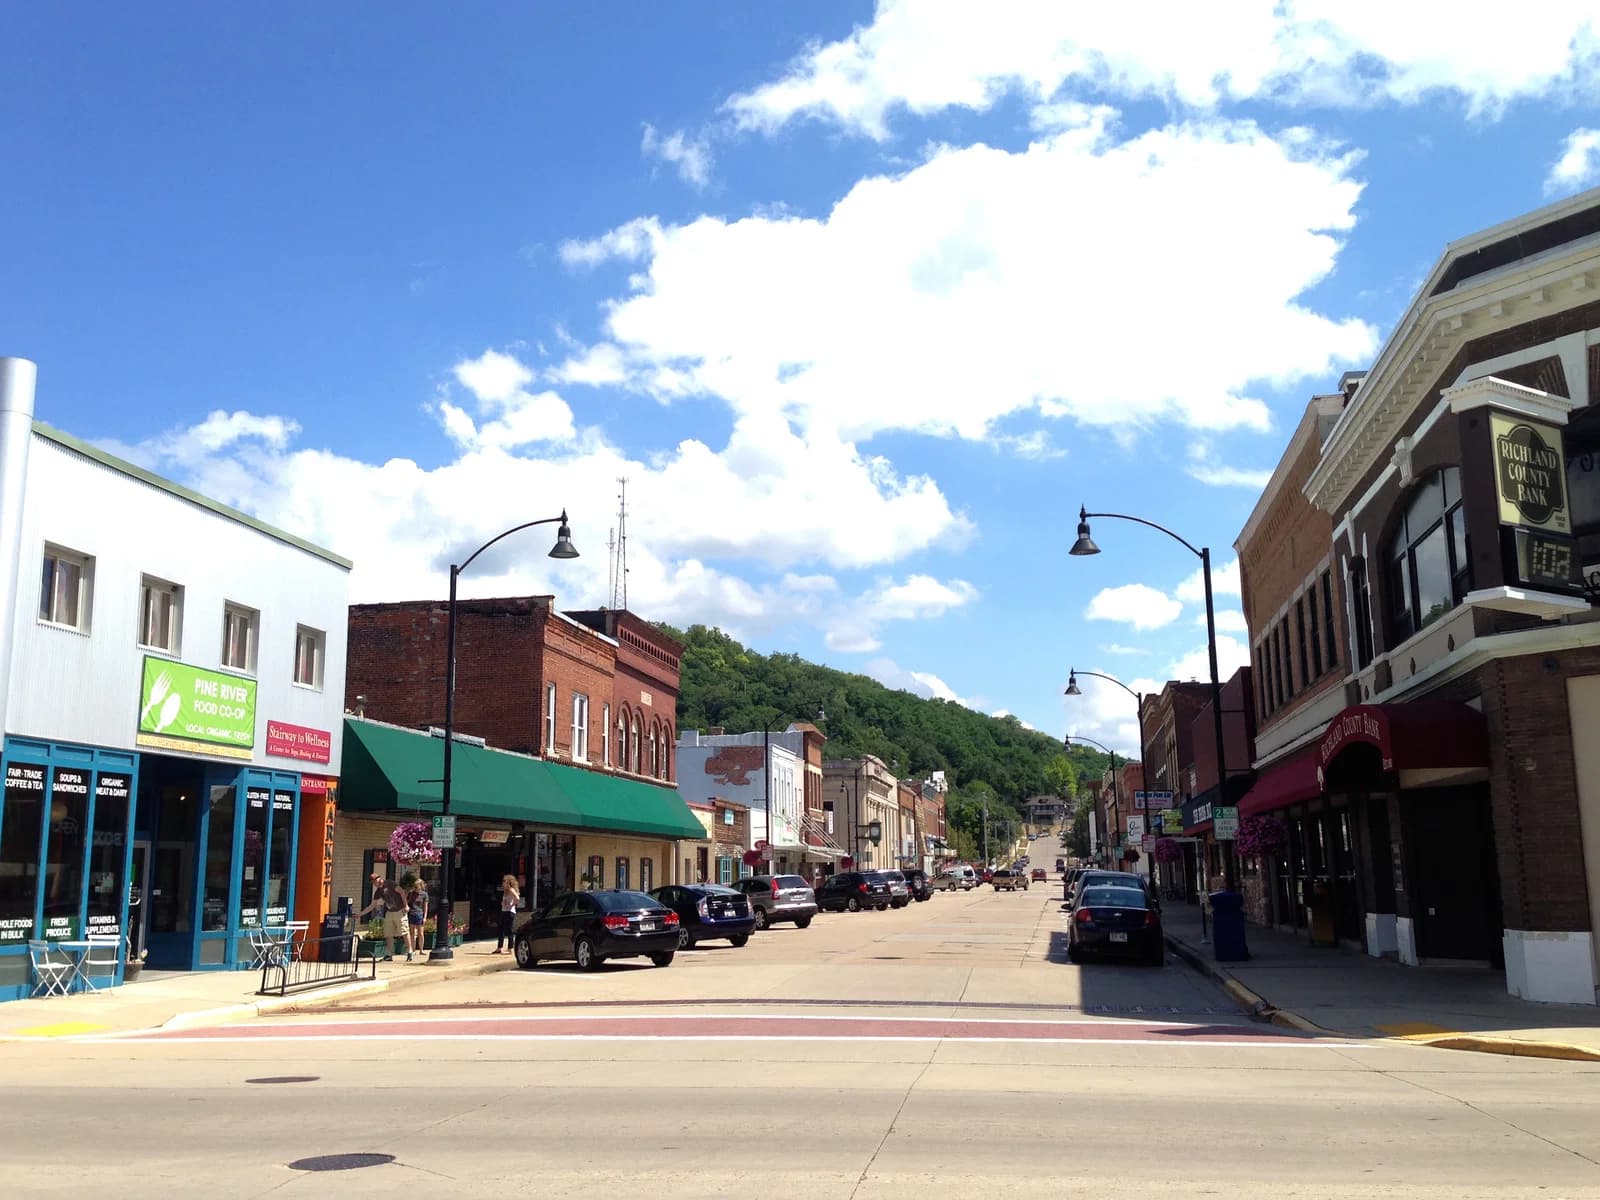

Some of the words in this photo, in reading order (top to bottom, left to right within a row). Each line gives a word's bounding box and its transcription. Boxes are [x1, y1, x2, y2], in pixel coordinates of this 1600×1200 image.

[1501, 441, 1557, 470] RICHLAND
[1508, 462, 1551, 488] COUNTY
[1517, 484, 1548, 506] BANK
[194, 678, 218, 697] PINE
[220, 684, 248, 704] RIVER
[194, 700, 218, 715] FOOD
[219, 704, 246, 720] CO-OP
[269, 726, 297, 746] Stairway
[298, 734, 304, 744] to
[305, 732, 329, 748] Wellness
[1321, 724, 1343, 764] RICHLAND
[1342, 715, 1362, 737] COUNTY
[1364, 712, 1380, 740] BANK
[60, 773, 78, 783] SOUPS
[301, 777, 326, 788] ENTRANCE
[5, 779, 27, 789] COFFEE
[28, 780, 32, 789] &
[33, 781, 44, 790] TEA
[435, 818, 441, 827] 2
[0, 919, 14, 929] HOLE
[14, 919, 33, 928] FOODS
[50, 917, 69, 927] FRESH
[1, 930, 7, 939] IN
[8, 930, 24, 939] BULK
[46, 927, 72, 937] PRODUCE
